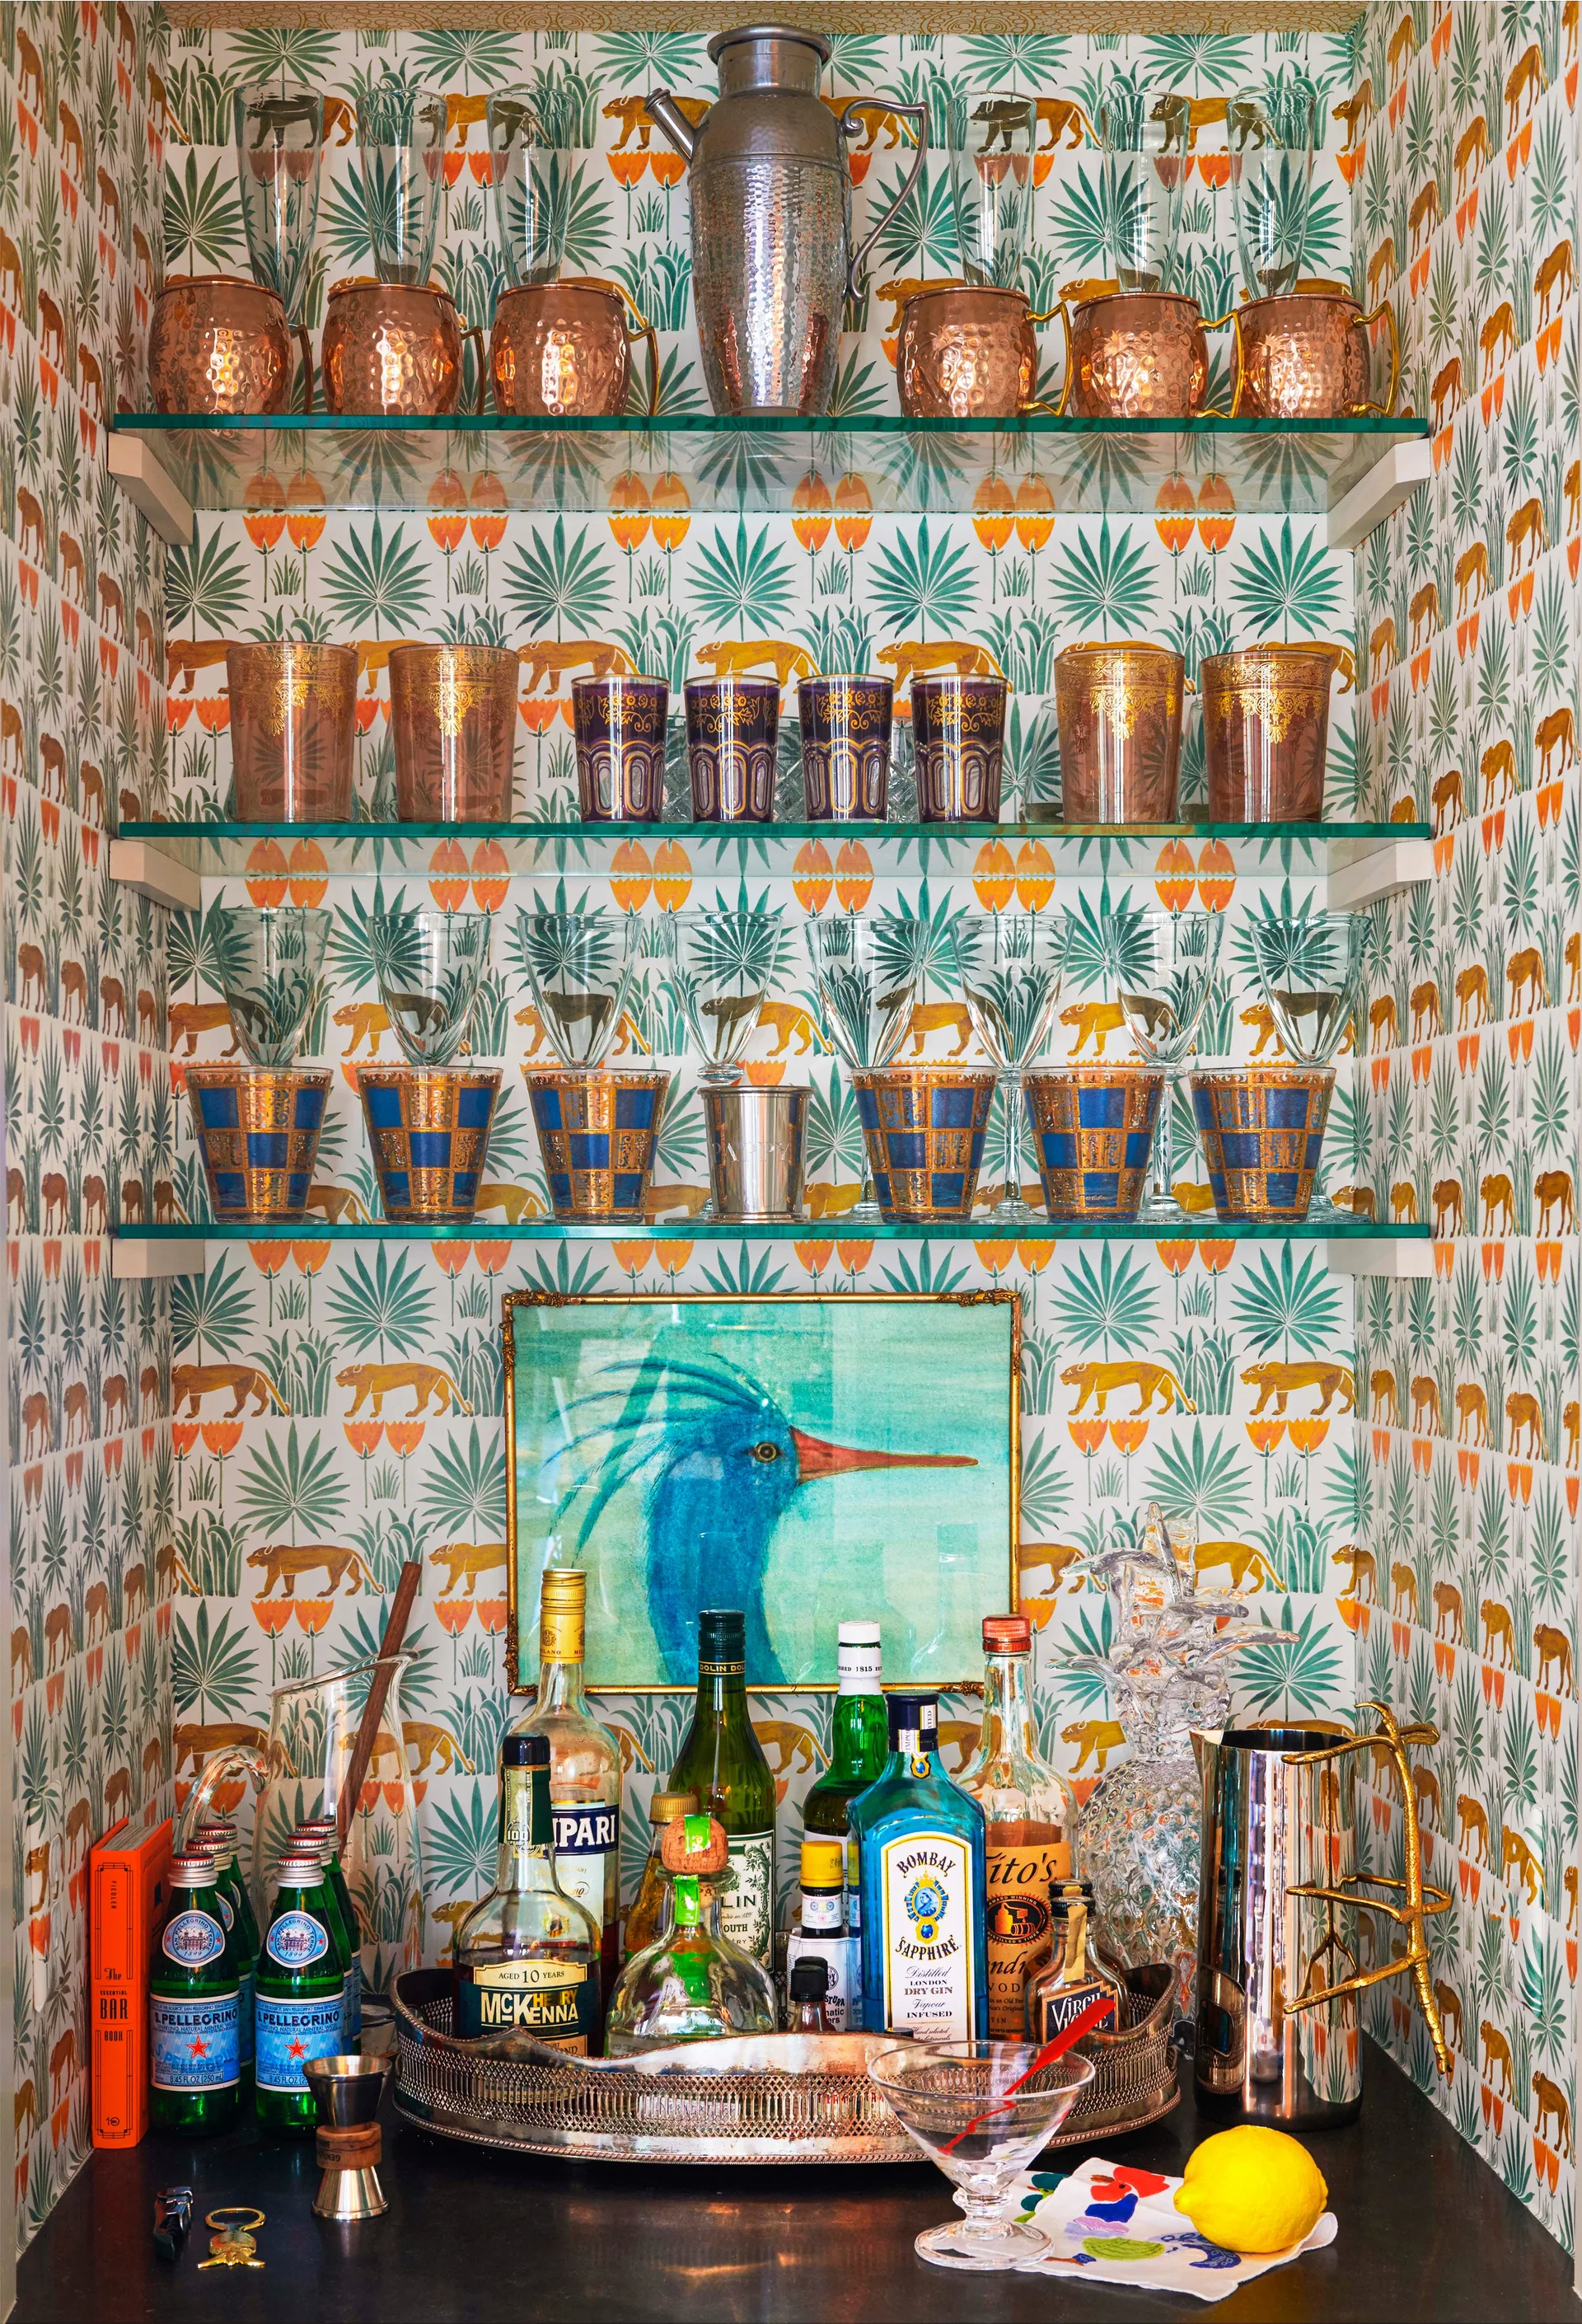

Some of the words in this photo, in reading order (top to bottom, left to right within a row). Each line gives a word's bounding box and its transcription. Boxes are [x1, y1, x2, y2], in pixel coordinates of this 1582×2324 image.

[700, 1664, 727, 1672] DOLIN
[507, 1830, 529, 1841] 100
[896, 1851, 957, 1879] BOMBAY
[989, 1895, 1009, 1906] AWARD
[1010, 1895, 1037, 1905] WINNING
[278, 1919, 311, 1937] PELLEGRINO
[175, 1918, 208, 1937] PELLEGRINO
[205, 1929, 213, 1952] TERME
[987, 1932, 1017, 1944] DISTILLED
[1023, 1930, 1040, 1942] TIMES
[895, 1934, 959, 1961] SAPPHIRE
[104, 1967, 122, 1980] The
[522, 1970, 540, 1984] 10
[542, 1970, 565, 1979] YEARS
[905, 1966, 952, 1979] Distilled
[904, 1988, 929, 1996] DRY
[929, 1986, 953, 1994] GIN
[100, 1998, 129, 2020] BAR
[911, 1998, 947, 2012] Vapour
[154, 2008, 237, 2026] S.PELLEGRINO
[906, 2010, 952, 2019] INFUSED
[104, 2030, 124, 2041] BOOK
[928, 2026, 951, 2035] selected
[170, 2074, 183, 2083] 8.45
[183, 2075, 190, 2083] FL
[190, 2075, 200, 2083] OZ
[269, 2075, 280, 2084] 8.45
[281, 2076, 288, 2084] FL
[288, 2076, 298, 2084] OZ
